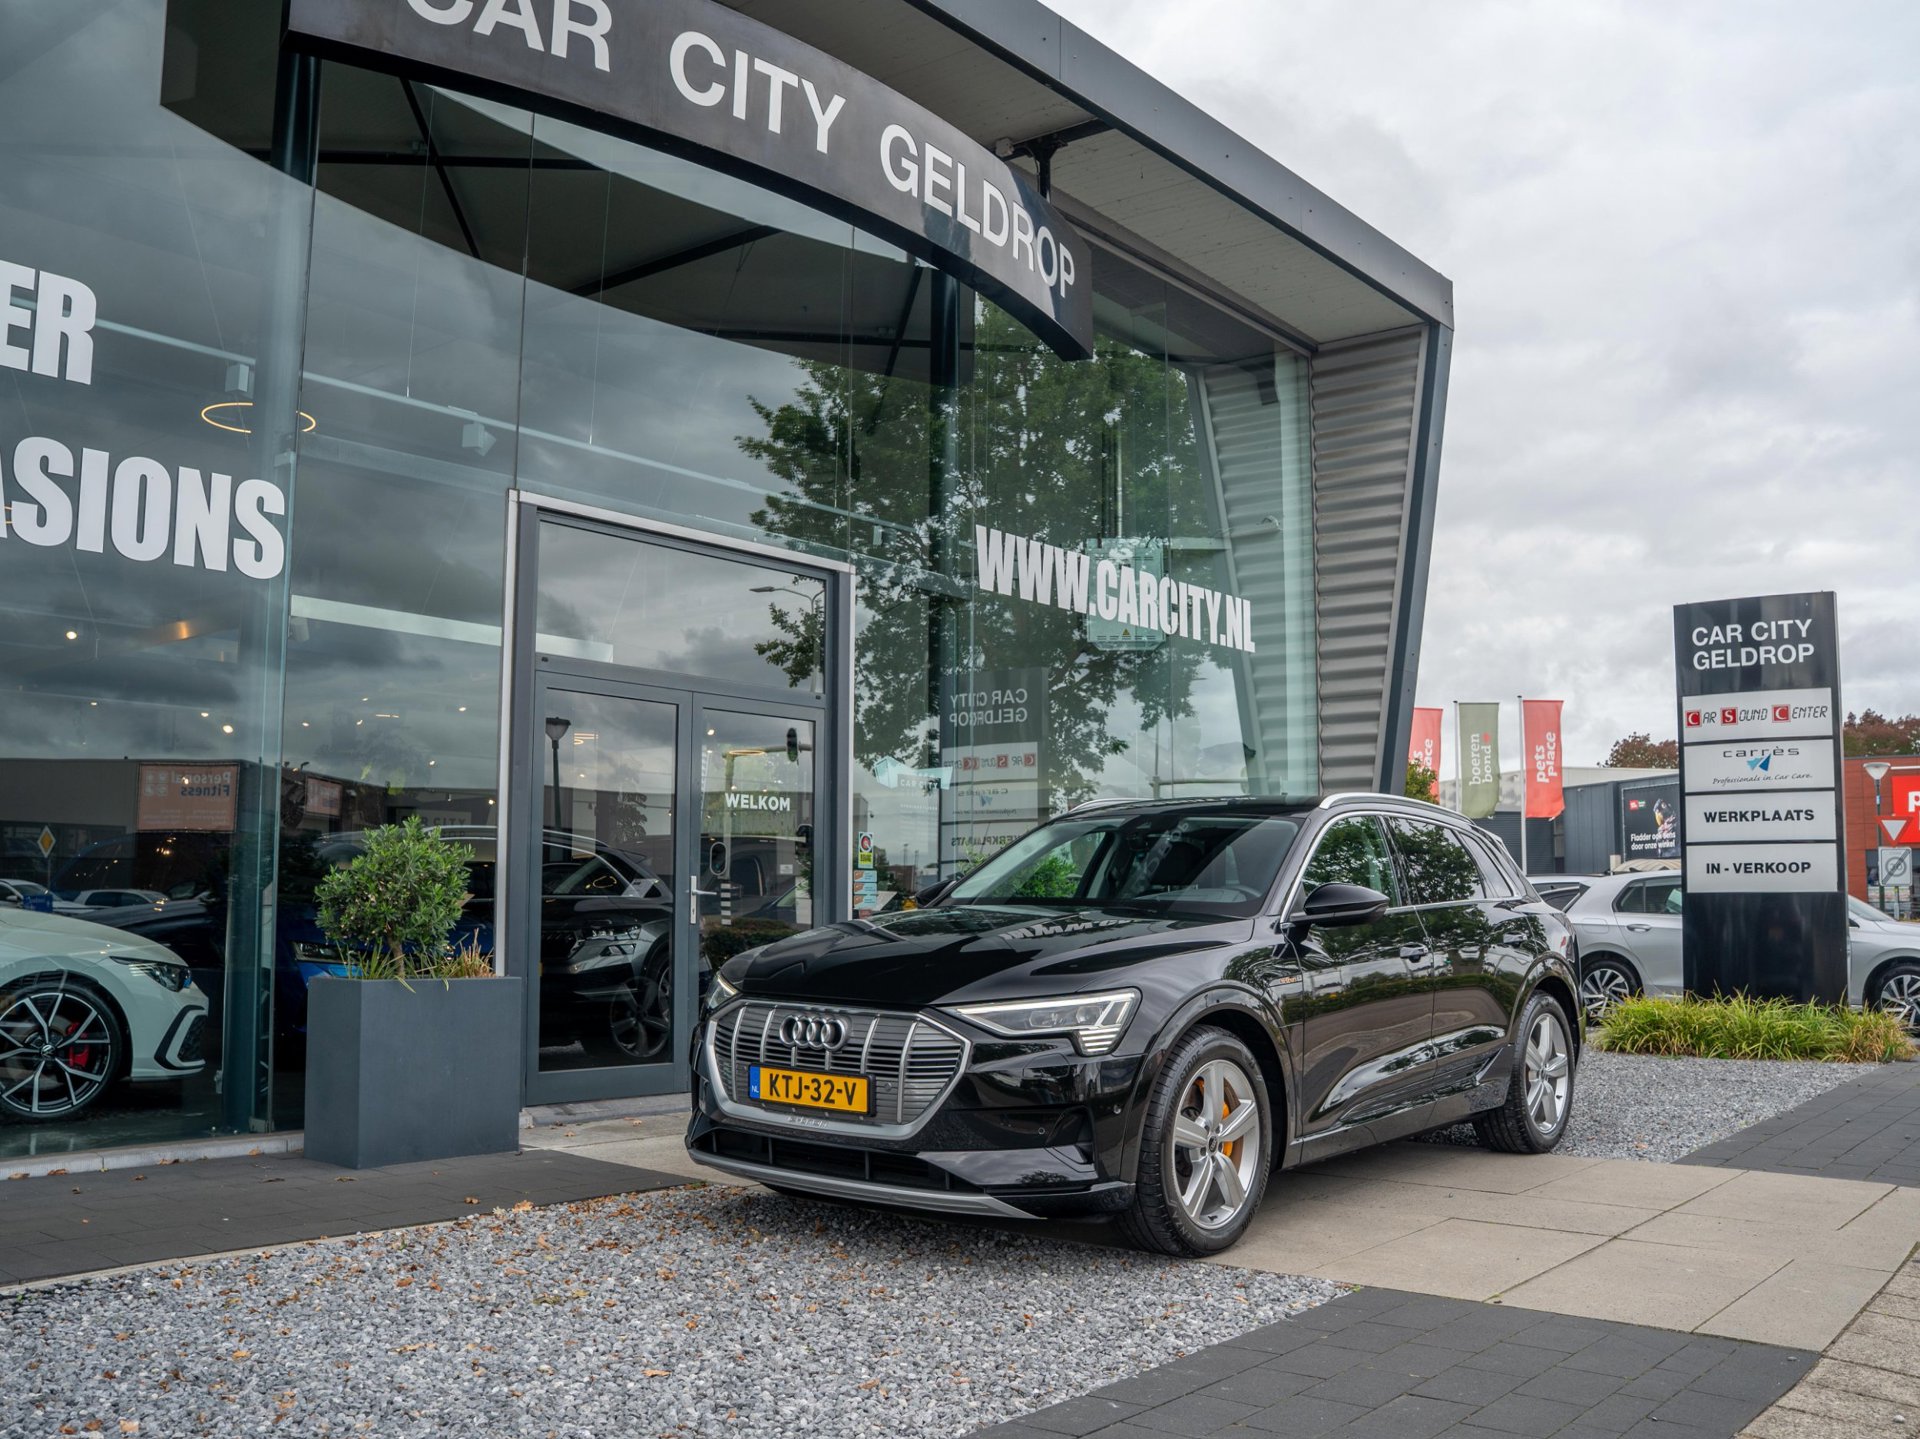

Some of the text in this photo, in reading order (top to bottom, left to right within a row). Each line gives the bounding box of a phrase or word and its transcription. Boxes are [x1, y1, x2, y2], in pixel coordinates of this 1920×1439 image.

[669, 31, 845, 153] CITY
[880, 124, 1075, 298] GELDROP
[0, 436, 285, 579] SIONS
[976, 524, 1255, 653] WWW.CARCITY.NL
[1692, 619, 1812, 646] CAR CITY
[1693, 644, 1815, 670] GELDROP
[1469, 733, 1481, 786] boeren
[1481, 745, 1493, 783] bond
[1534, 745, 1549, 783] pets
[1545, 731, 1557, 777] place
[1723, 746, 1800, 758] carrès
[725, 793, 790, 812] WELKOM
[1704, 809, 1814, 823] WERKPLAATS
[1733, 862, 1811, 874] VERKOOP
[751, 1085, 760, 1094] NL
[769, 1073, 857, 1106] KTJ-32-V
